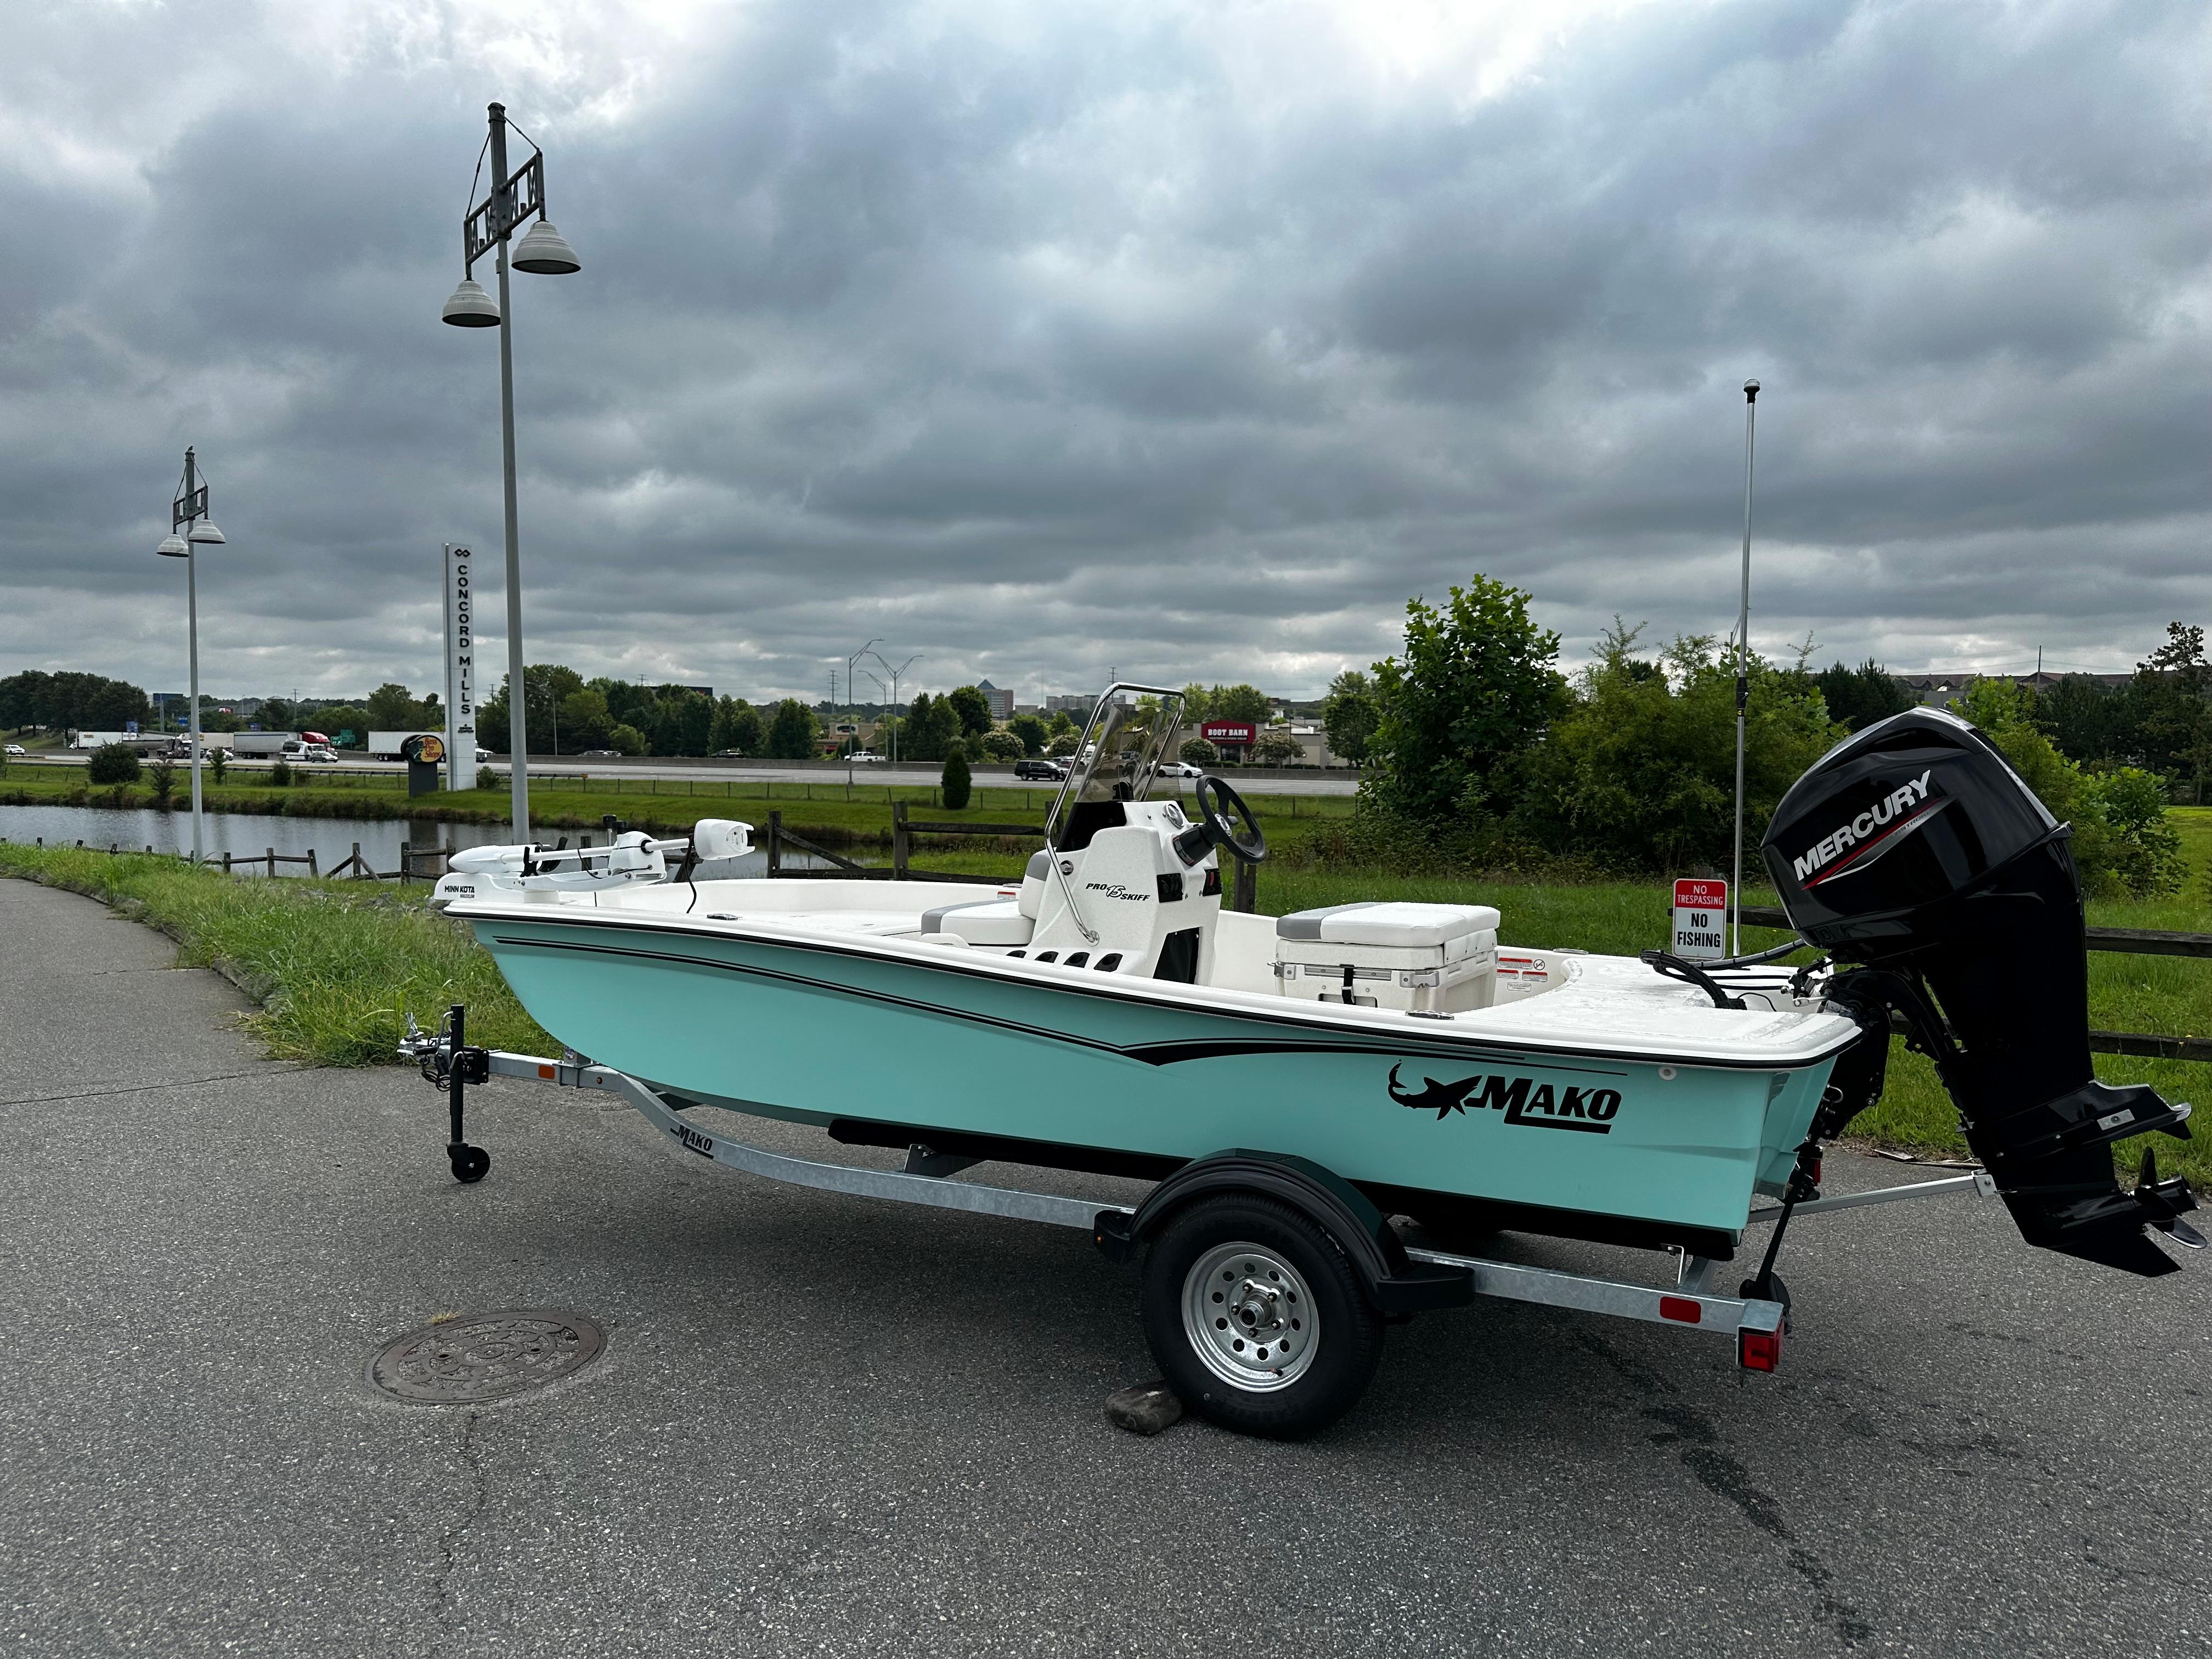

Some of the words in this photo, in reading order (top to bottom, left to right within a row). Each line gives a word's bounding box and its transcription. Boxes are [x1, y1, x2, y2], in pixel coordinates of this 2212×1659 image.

[458, 565, 470, 647] CONCORD
[459, 656, 471, 714] MILLS
[425, 737, 437, 745] Bass
[424, 751, 441, 759] Shops
[1793, 769, 1931, 881] MERCURY
[1106, 885, 1126, 898] 15
[1693, 885, 1707, 895] NO
[1677, 894, 1723, 905] TRESPASSING
[1691, 913, 1708, 928] NO
[1677, 931, 1720, 948] FISHING
[1463, 1075, 1622, 1135] MAKO
[670, 1124, 714, 1160] MAKO
